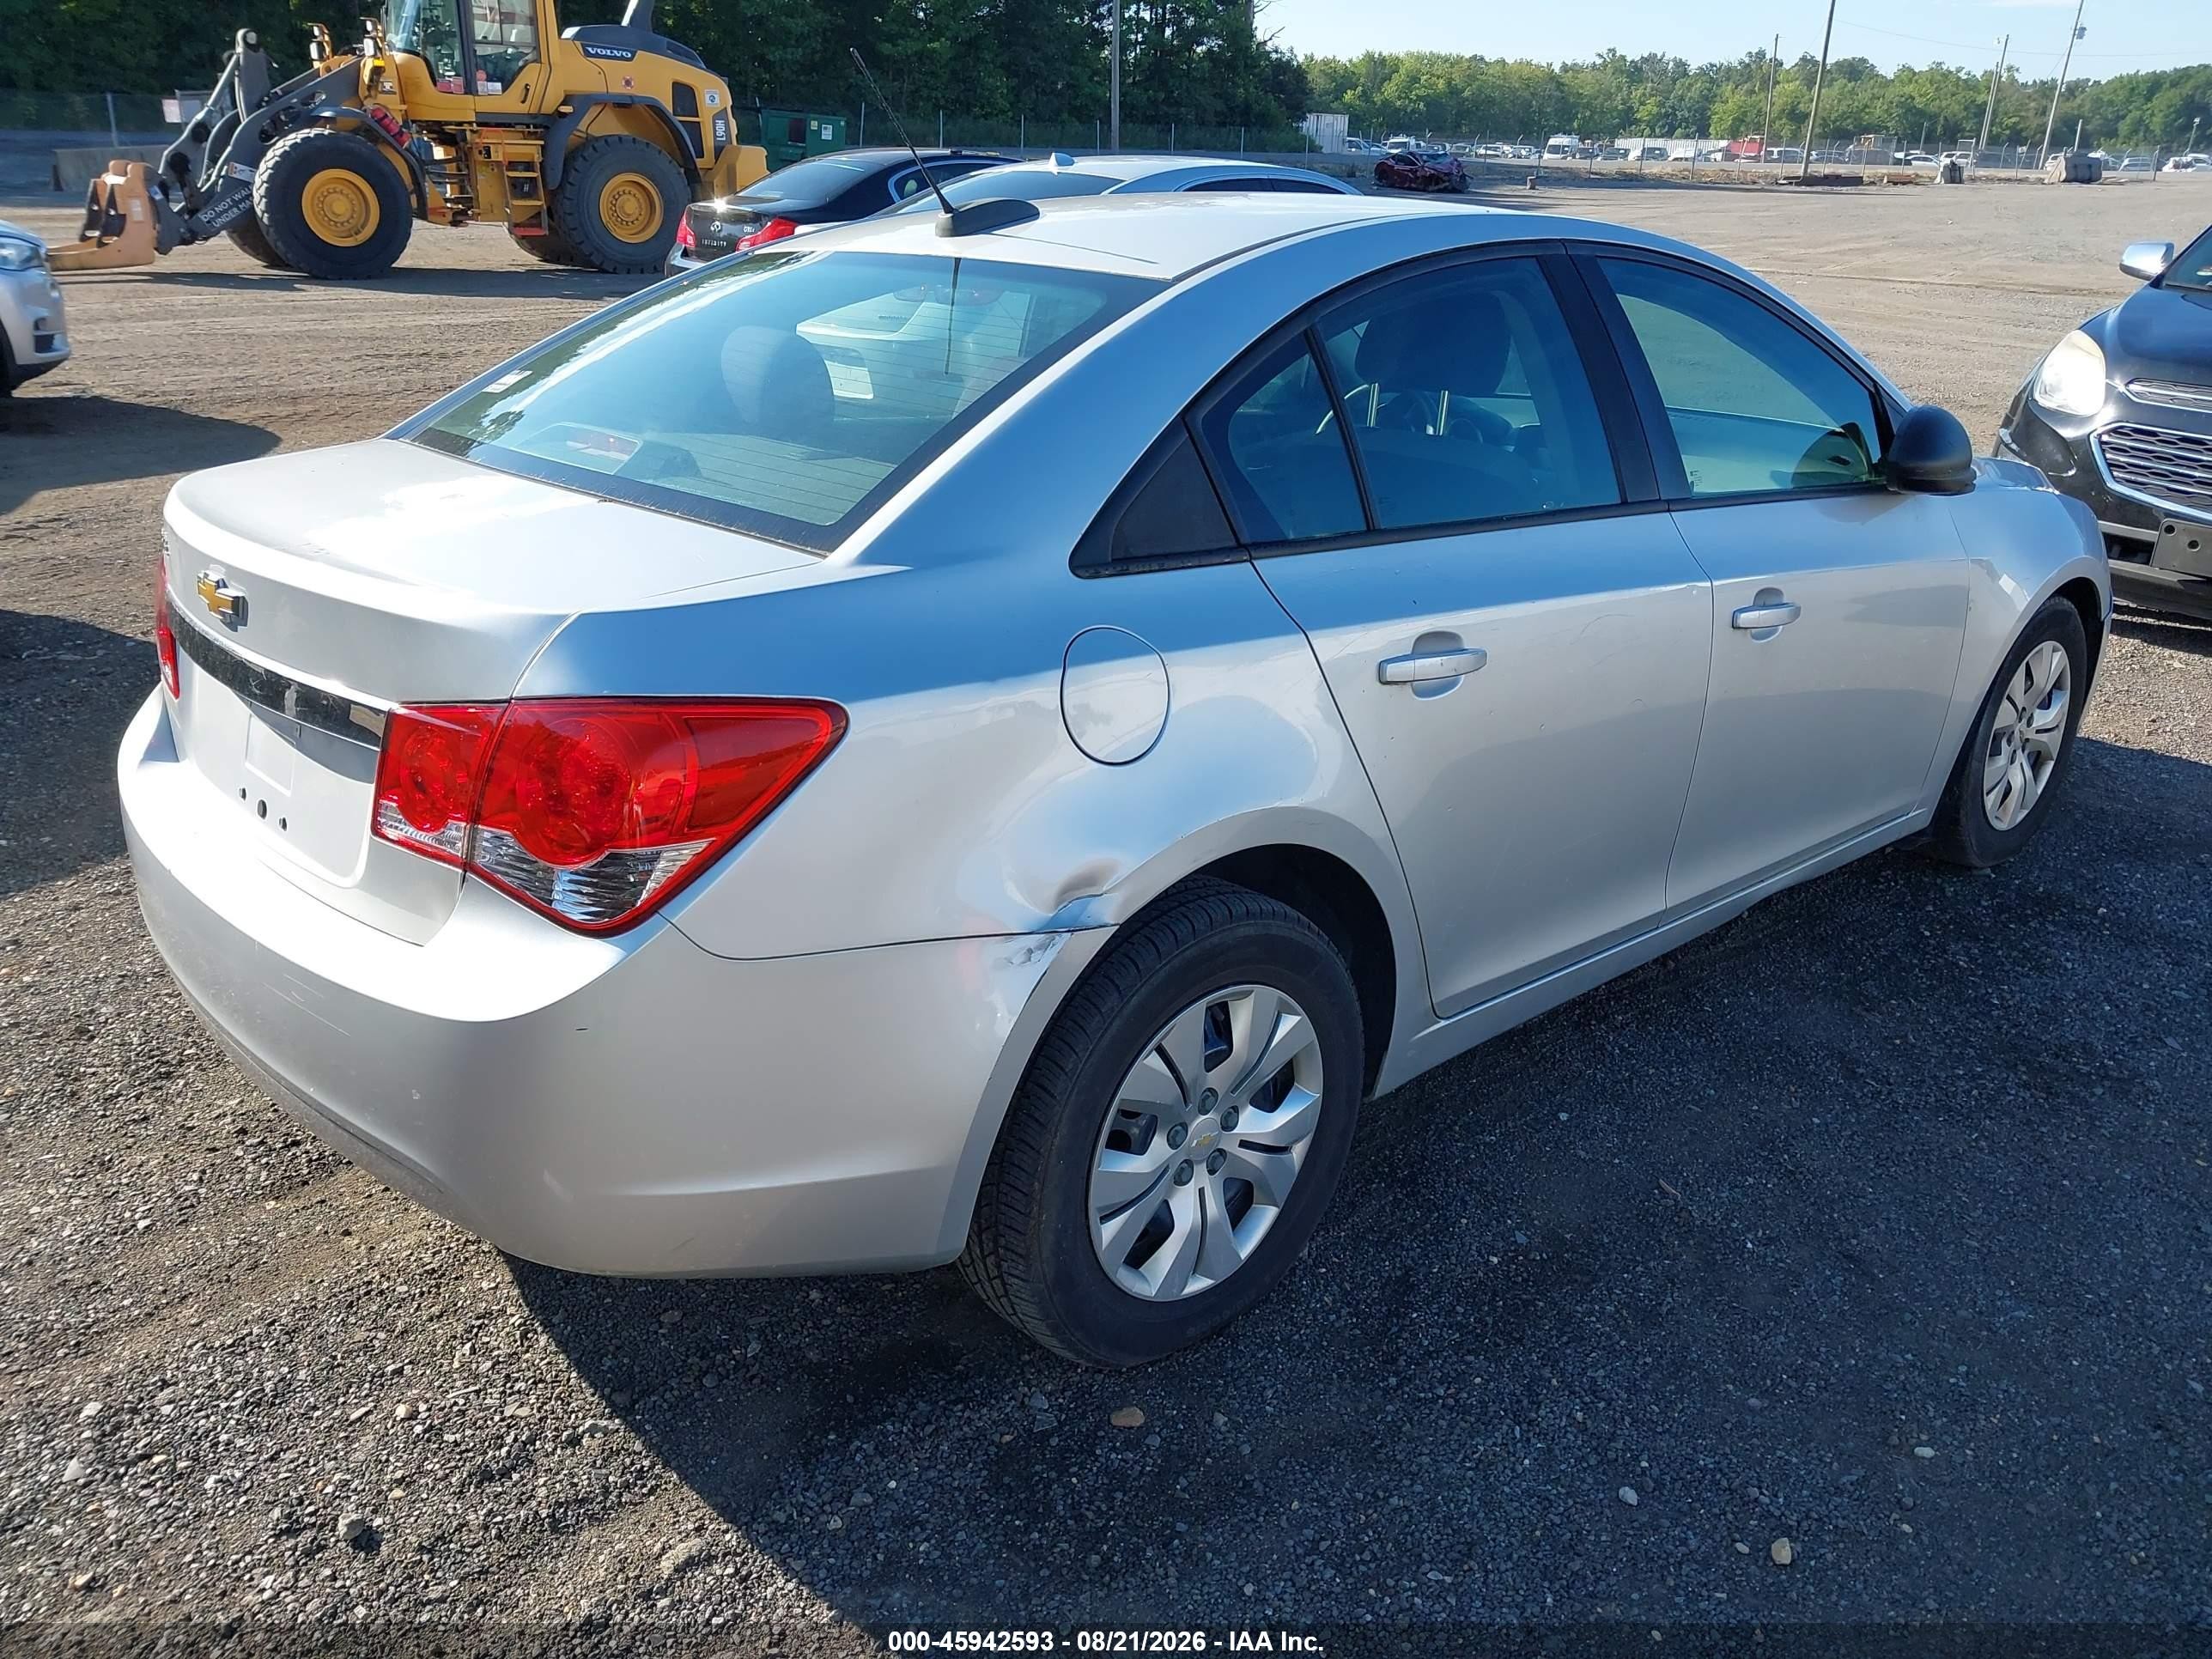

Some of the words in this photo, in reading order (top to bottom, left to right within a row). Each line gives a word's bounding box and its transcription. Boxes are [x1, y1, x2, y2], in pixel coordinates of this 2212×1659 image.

[585, 46, 632, 58] VOLVO
[715, 119, 726, 141] L90H
[200, 210, 215, 222] DO
[215, 198, 234, 213] NOT
[212, 207, 240, 228] UNDER
